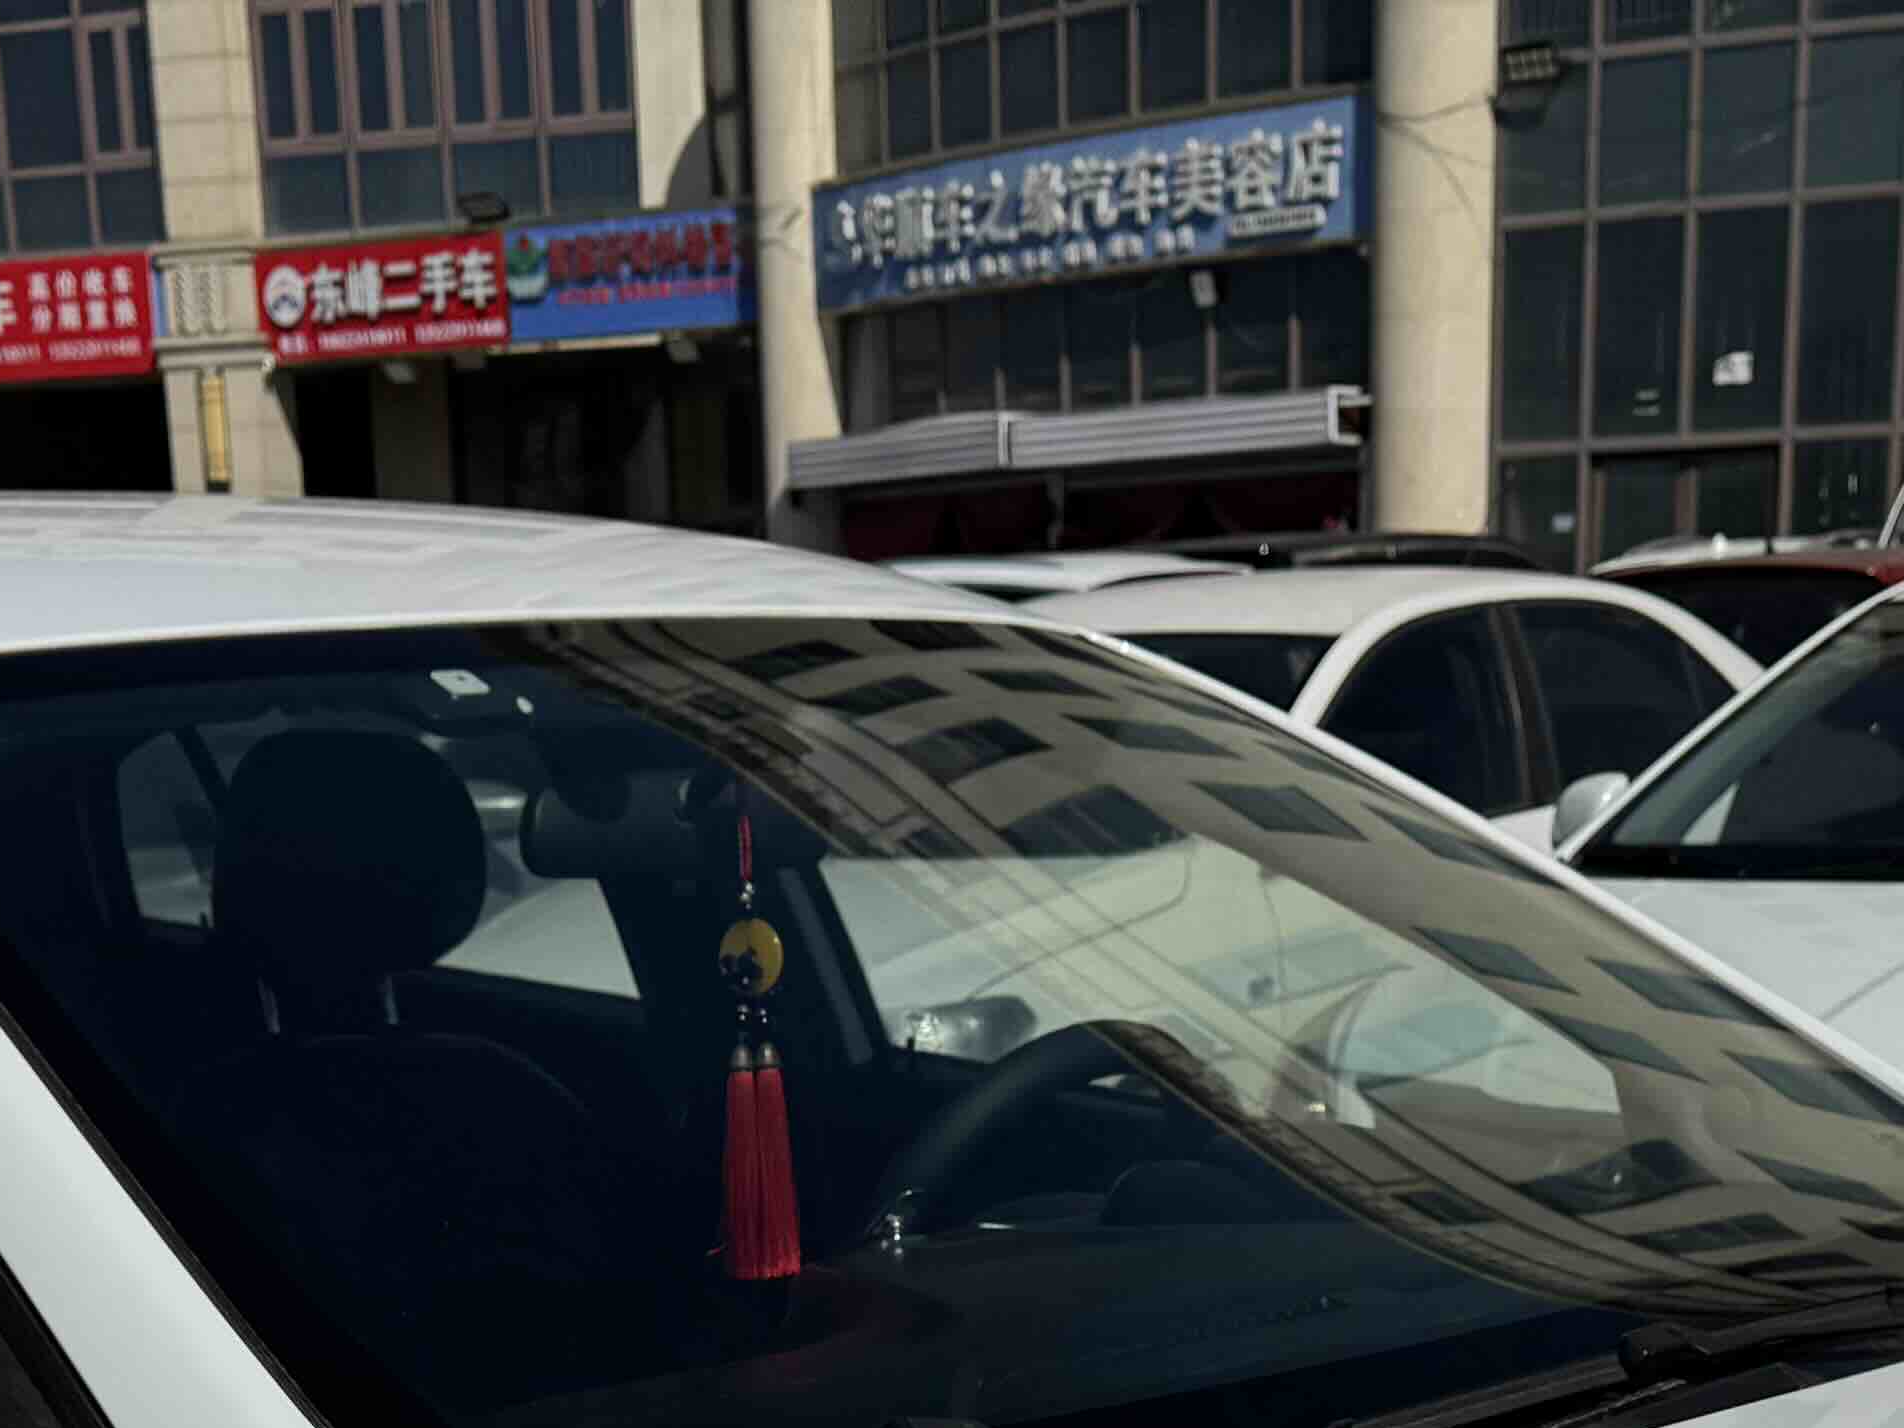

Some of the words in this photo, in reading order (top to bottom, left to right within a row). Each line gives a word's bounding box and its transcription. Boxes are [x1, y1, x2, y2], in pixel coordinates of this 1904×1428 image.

[309, 248, 499, 322] 东峰二手车
